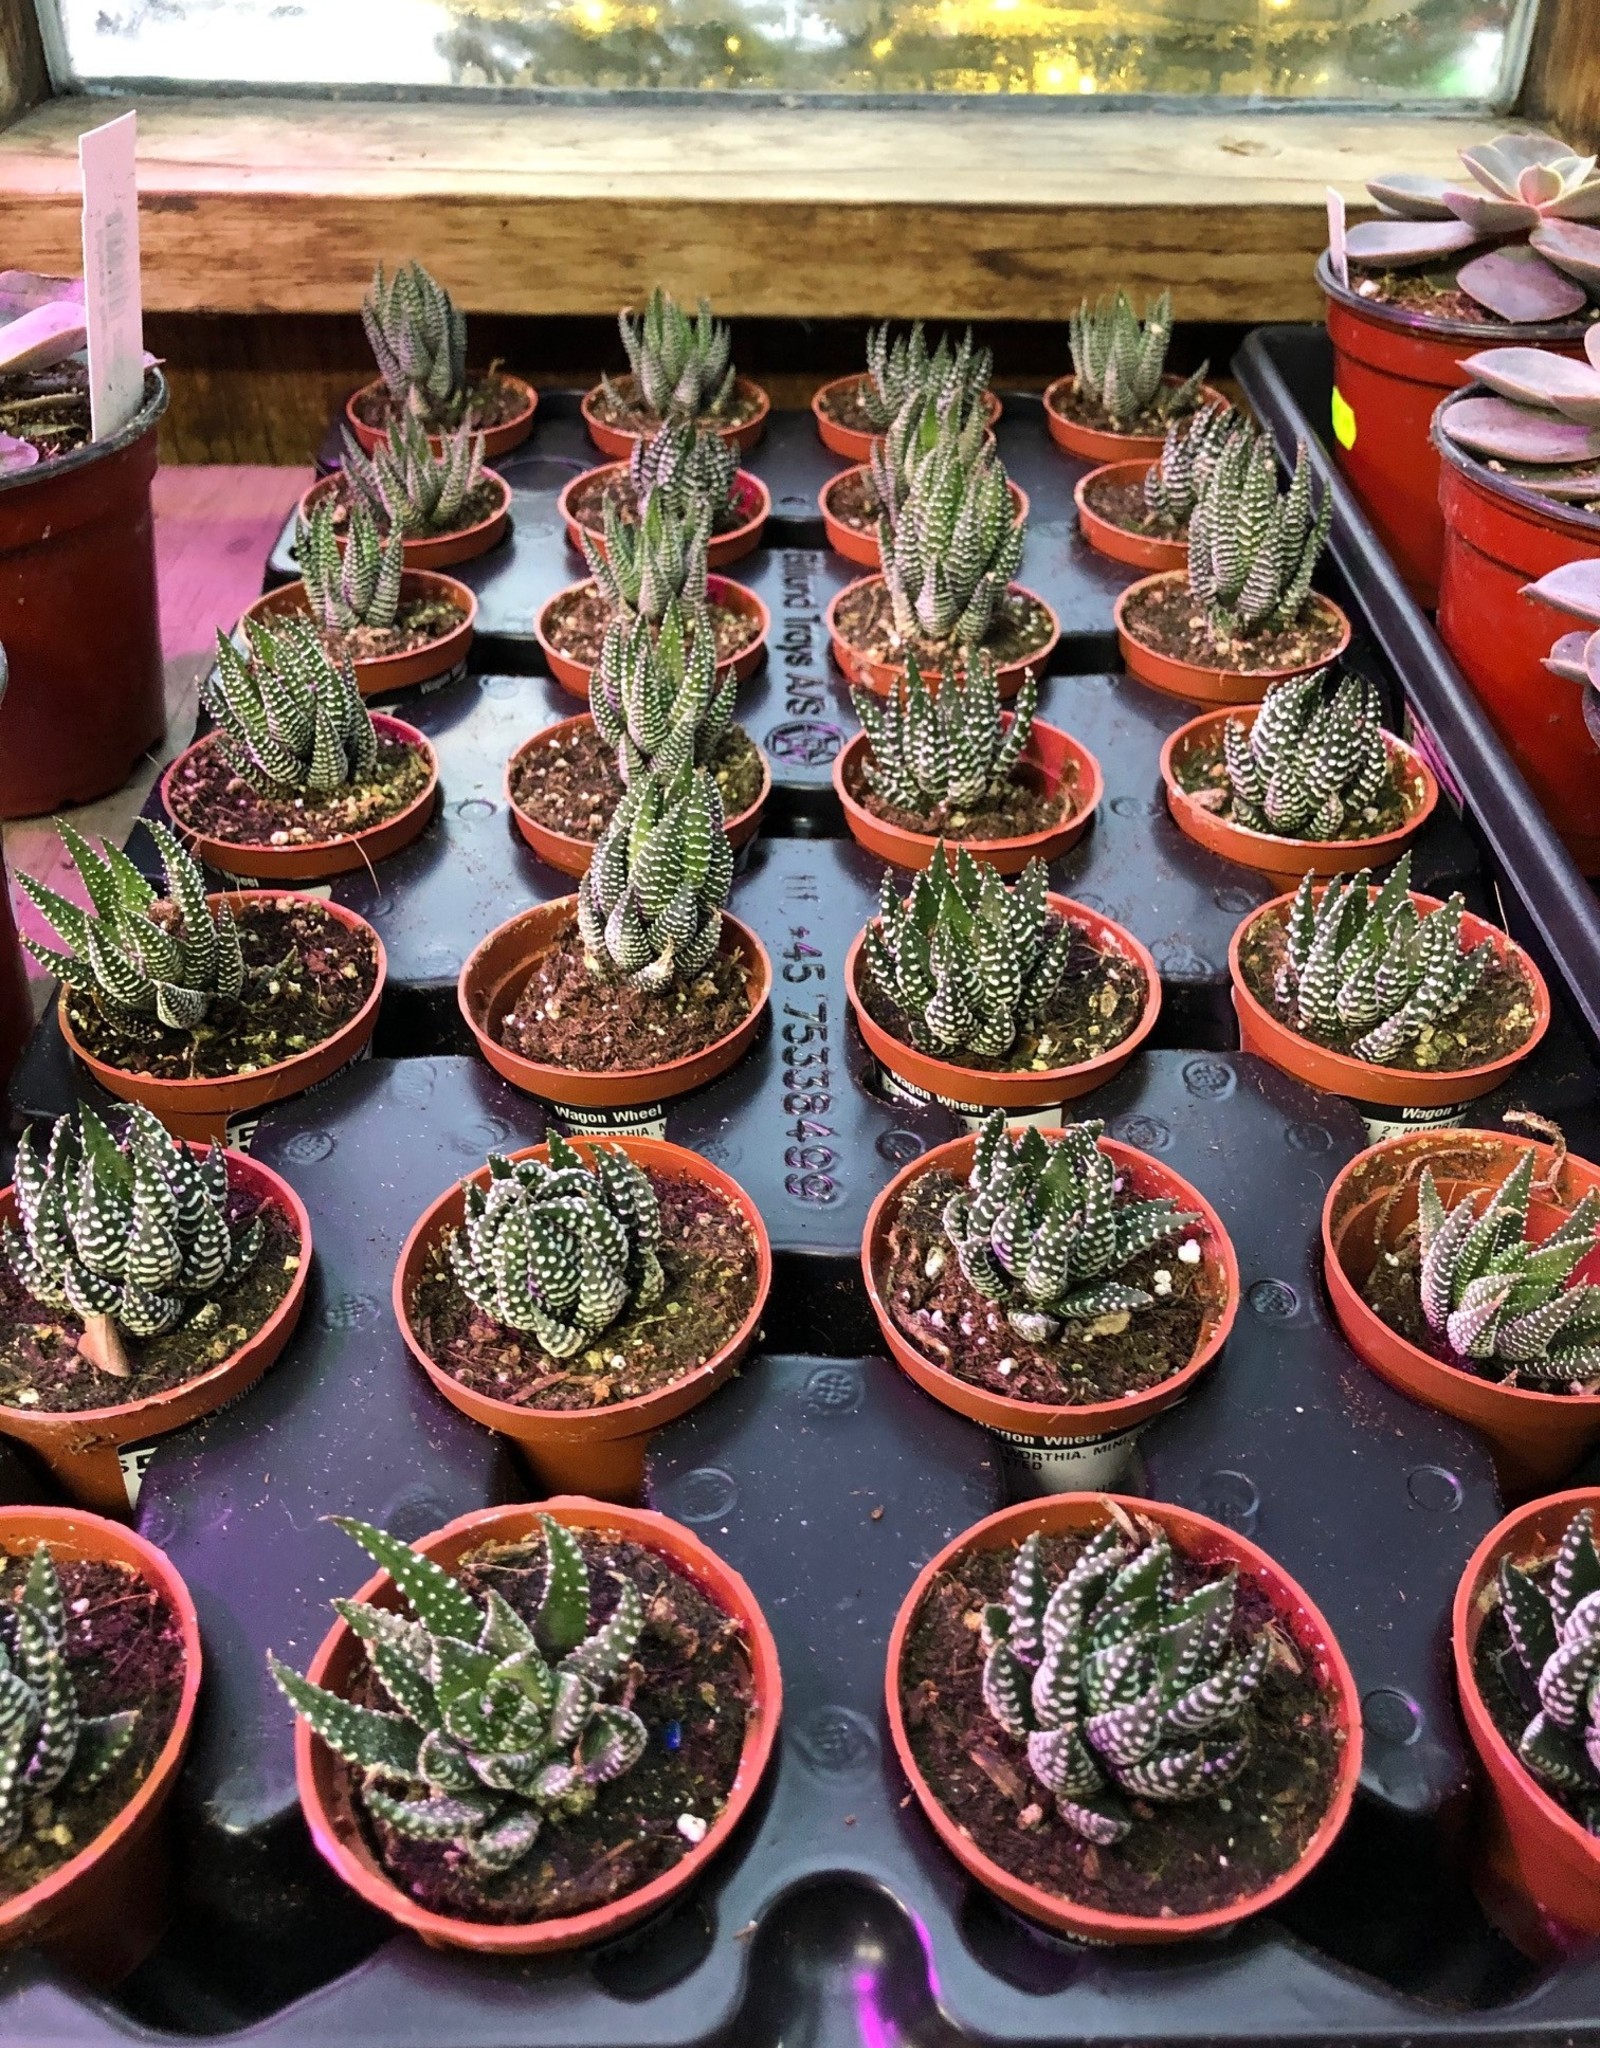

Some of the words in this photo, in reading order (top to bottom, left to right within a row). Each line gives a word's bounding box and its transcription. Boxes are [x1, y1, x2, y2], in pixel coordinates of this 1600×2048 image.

[776, 614, 822, 667] Trays
[785, 673, 826, 716] A/S
[890, 1069, 931, 1101] Wagon
[936, 1093, 984, 1113] Wheel
[554, 1105, 607, 1124] Wagon
[613, 1104, 662, 1123] Wheel
[1402, 1107, 1453, 1121] Wagon
